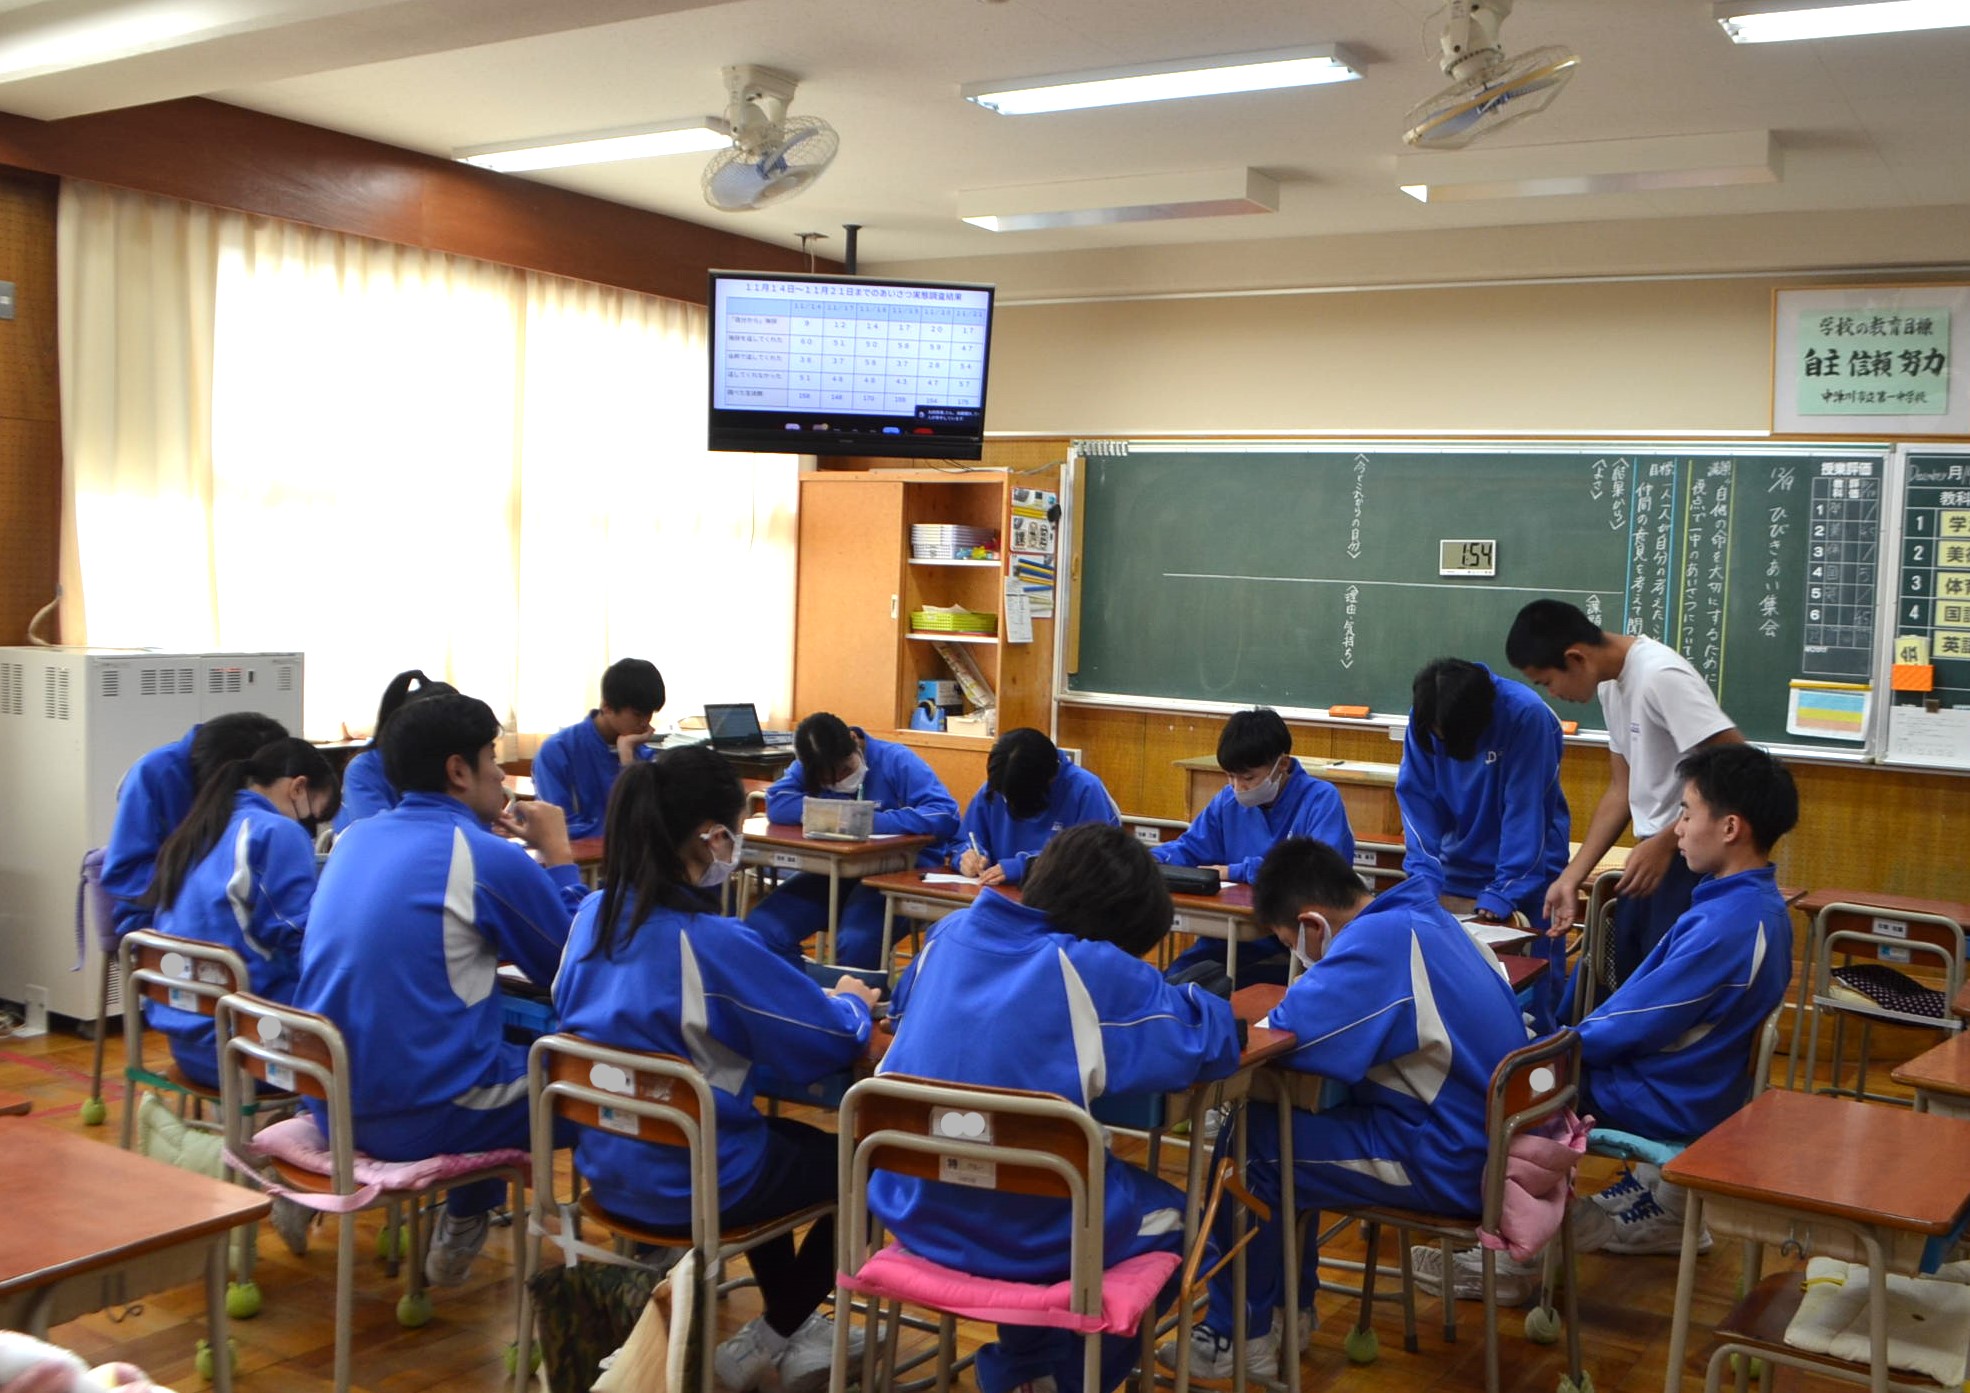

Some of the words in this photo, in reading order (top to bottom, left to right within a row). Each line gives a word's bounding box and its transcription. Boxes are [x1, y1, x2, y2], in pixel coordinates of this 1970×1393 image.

[1819, 315, 1934, 337] 学校の教育目標
[1804, 347, 1841, 377] 自主
[1849, 349, 1893, 377] 信頼
[1898, 347, 1946, 377] 努力
[1947, 465, 1963, 480] 月
[1939, 491, 1970, 506] 教科
[1816, 504, 1824, 515] 1
[1814, 525, 1825, 536] 2
[1916, 515, 1925, 531] 1
[1949, 516, 1970, 533] 学
[1462, 543, 1492, 567] 1:54
[1812, 546, 1823, 557] 3
[1913, 545, 1924, 560] 2
[1947, 545, 1970, 563] 美
[1758, 506, 1790, 638] ひびきあい集会
[1812, 567, 1822, 577] 4
[1911, 575, 1921, 590] 3
[1811, 588, 1821, 598] 5
[1810, 609, 1820, 620] 6
[1909, 604, 1920, 620] 4
